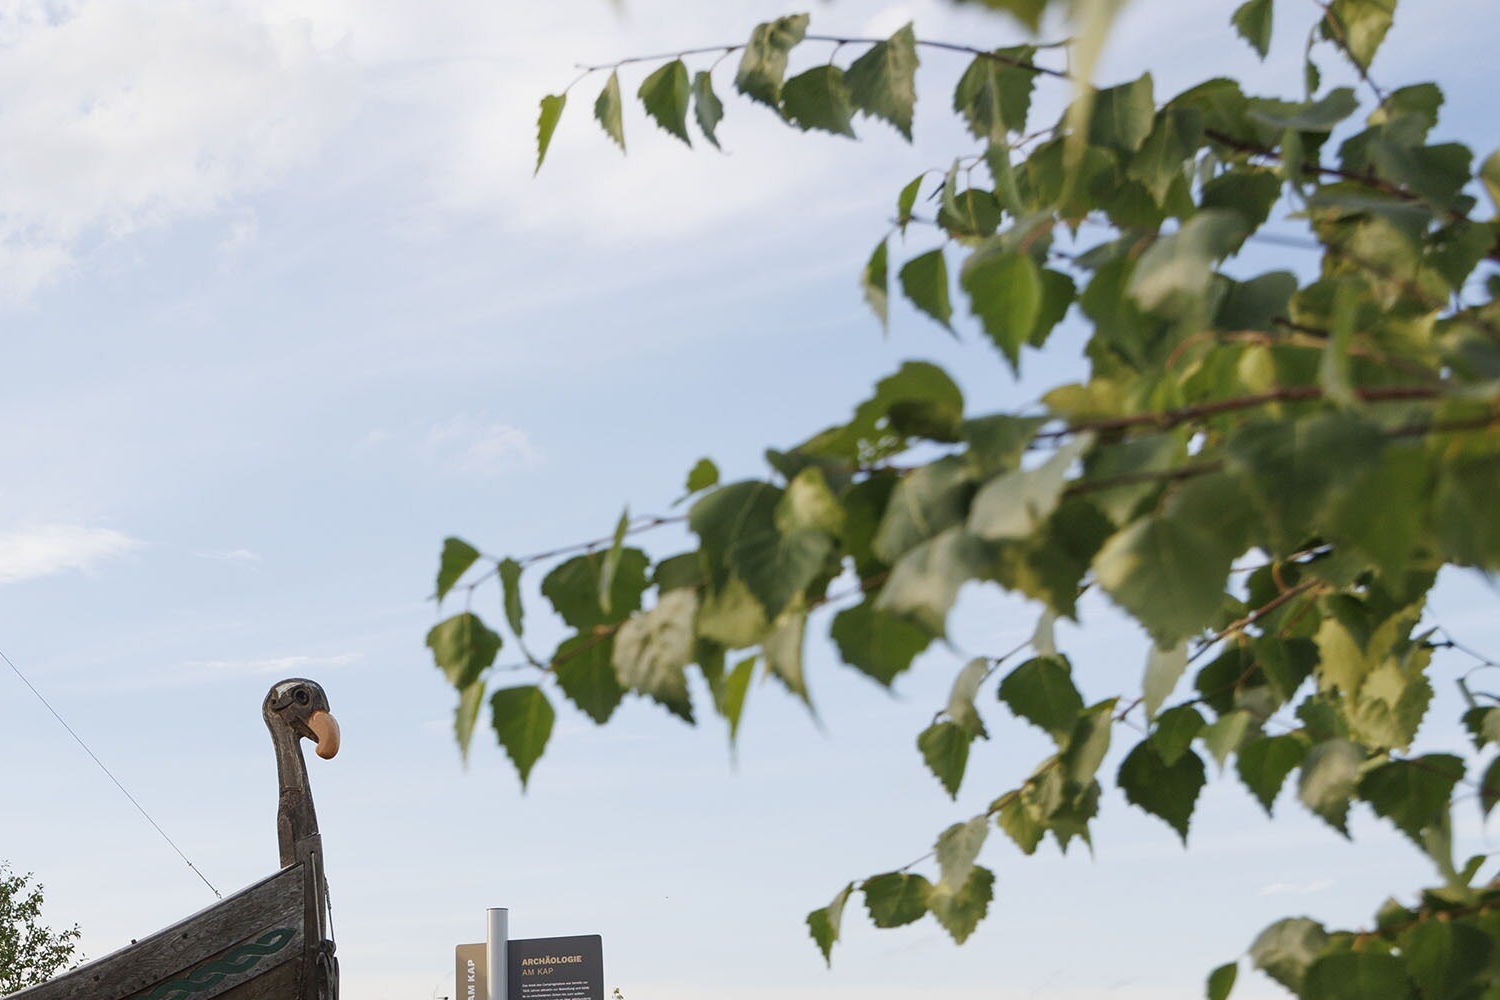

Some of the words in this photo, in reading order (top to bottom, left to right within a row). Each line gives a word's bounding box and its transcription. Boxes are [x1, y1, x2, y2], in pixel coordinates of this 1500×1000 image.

[522, 955, 582, 966] ARCHÄOLOGIE
[467, 959, 476, 982] KAP
[522, 968, 535, 976] AM
[537, 967, 554, 976] KAP
